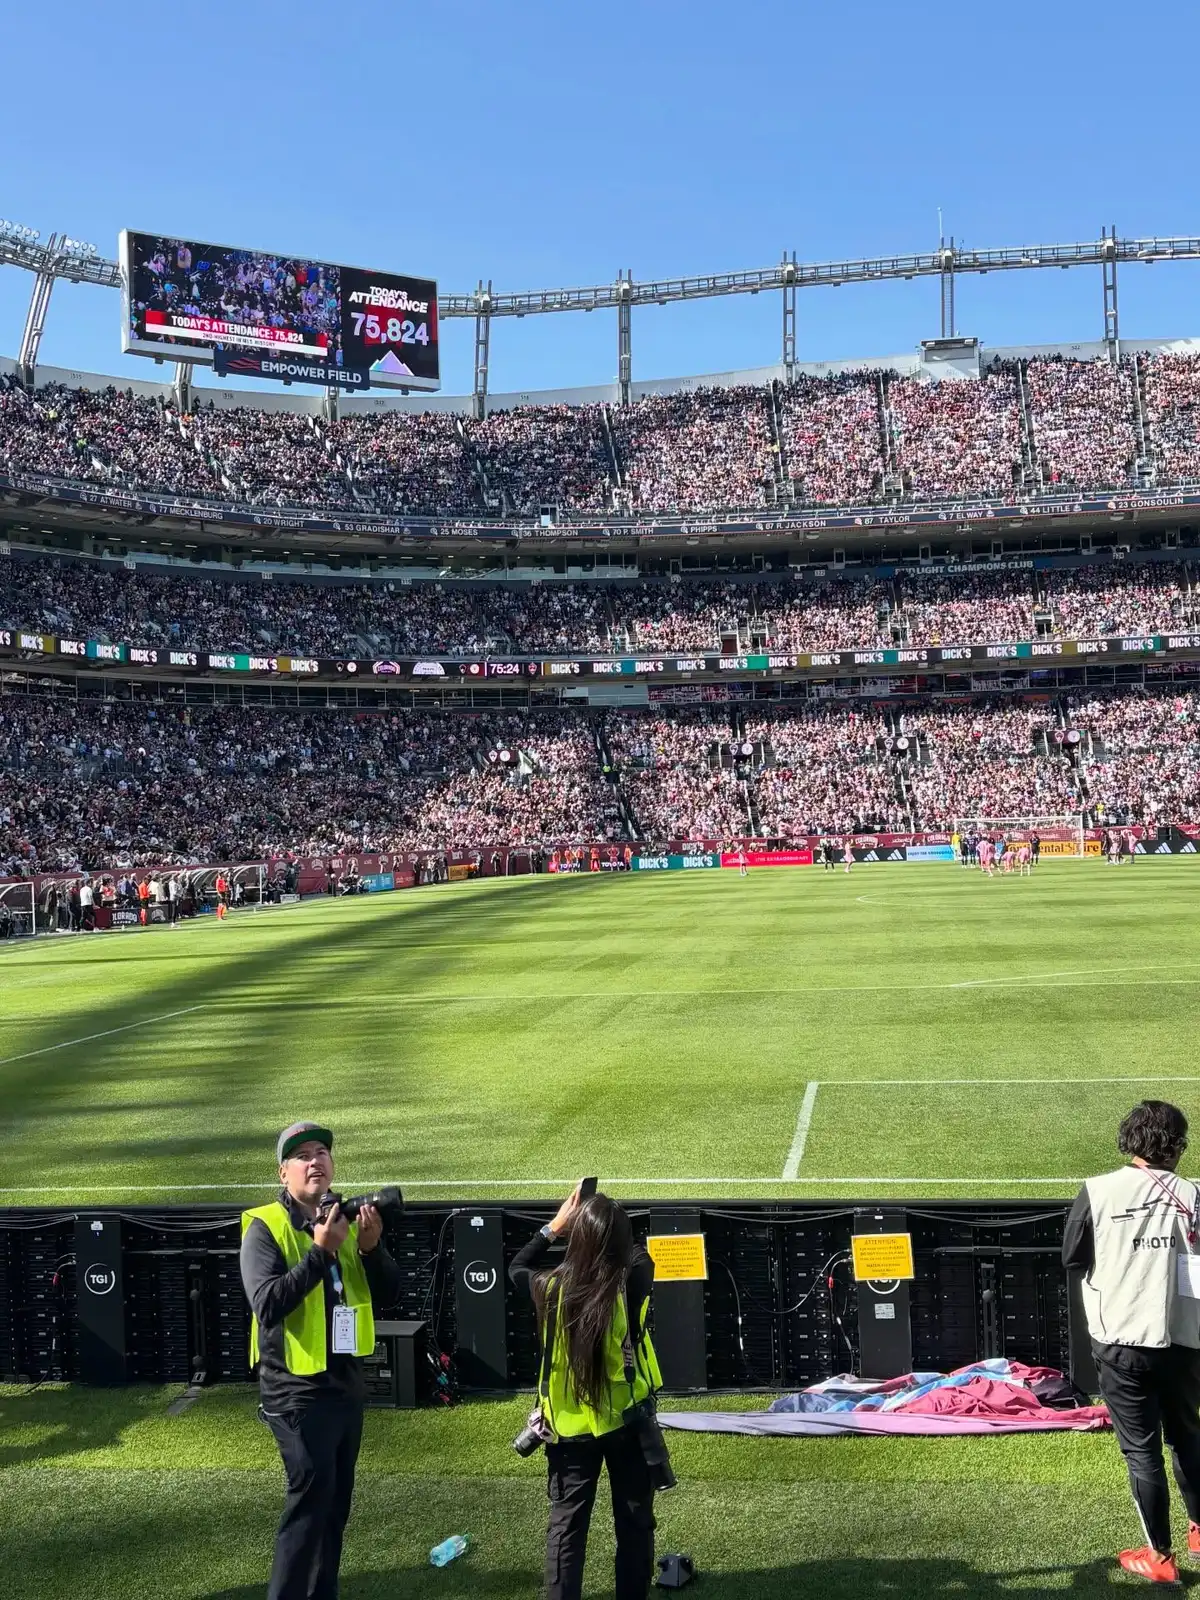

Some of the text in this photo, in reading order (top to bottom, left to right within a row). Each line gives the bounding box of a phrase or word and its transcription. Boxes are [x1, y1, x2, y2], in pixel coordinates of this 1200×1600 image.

[369, 286, 408, 300] TODAY'S
[348, 291, 429, 313] ATTENDANCE
[171, 315, 304, 343] TODAY'S ATTENDANCE: 75,824
[350, 312, 430, 346] 75,824
[261, 361, 362, 384] EMPOWER FIELD
[100, 495, 133, 508] ATWATER
[1118, 498, 1184, 509] 23 GONSOULIN
[159, 505, 223, 520] 77 MECKLENBURG
[956, 511, 983, 519] ELWAY
[1042, 505, 1070, 514] LITTLE
[263, 518, 304, 528] 20 WRIGHT
[785, 520, 827, 529] JACKSON
[878, 516, 910, 524] TAYLOR
[344, 523, 400, 534] 53 GRADISHAR
[440, 528, 478, 536] 25 MOSES
[535, 529, 579, 537] THOMPSON
[630, 528, 654, 536] SMITH
[690, 525, 717, 533] PHIPPS
[917, 566, 945, 574] LIGHT
[947, 562, 1007, 573] CHAMPIONS
[1007, 560, 1034, 569] CLUB
[20, 634, 44, 650] DICK'S
[60, 640, 86, 655] DICK'S
[1077, 641, 1108, 653] DICK'S
[1122, 639, 1154, 651] DICK'S
[1168, 636, 1200, 648] DICK'S
[96, 644, 120, 660] DICK'S
[941, 648, 972, 659] DICK'S
[986, 645, 1017, 657] DICK'S
[1031, 643, 1063, 655] DICK'S
[130, 648, 158, 663] DICK'S
[169, 652, 197, 666] DICK'S
[209, 654, 236, 669] DICK'S
[811, 654, 841, 665] DICK'S
[854, 652, 884, 664] DICK'S
[898, 650, 928, 662] DICK'S
[249, 657, 278, 670] DICK'S
[290, 659, 319, 672] DICK'S
[551, 662, 580, 674] DICK'S
[593, 662, 622, 673] DICK'S
[635, 661, 664, 672] DICK'S
[677, 659, 706, 670] DICK'S
[719, 658, 748, 669] DICK'S
[768, 656, 798, 668] DICK'S
[490, 663, 520, 674] 75:24
[681, 842, 704, 851] DICK'S
[639, 857, 669, 869] DICK'S
[683, 855, 713, 868] DICK'S
[89, 1274, 108, 1284] TGI
[469, 1272, 489, 1283] TGI
